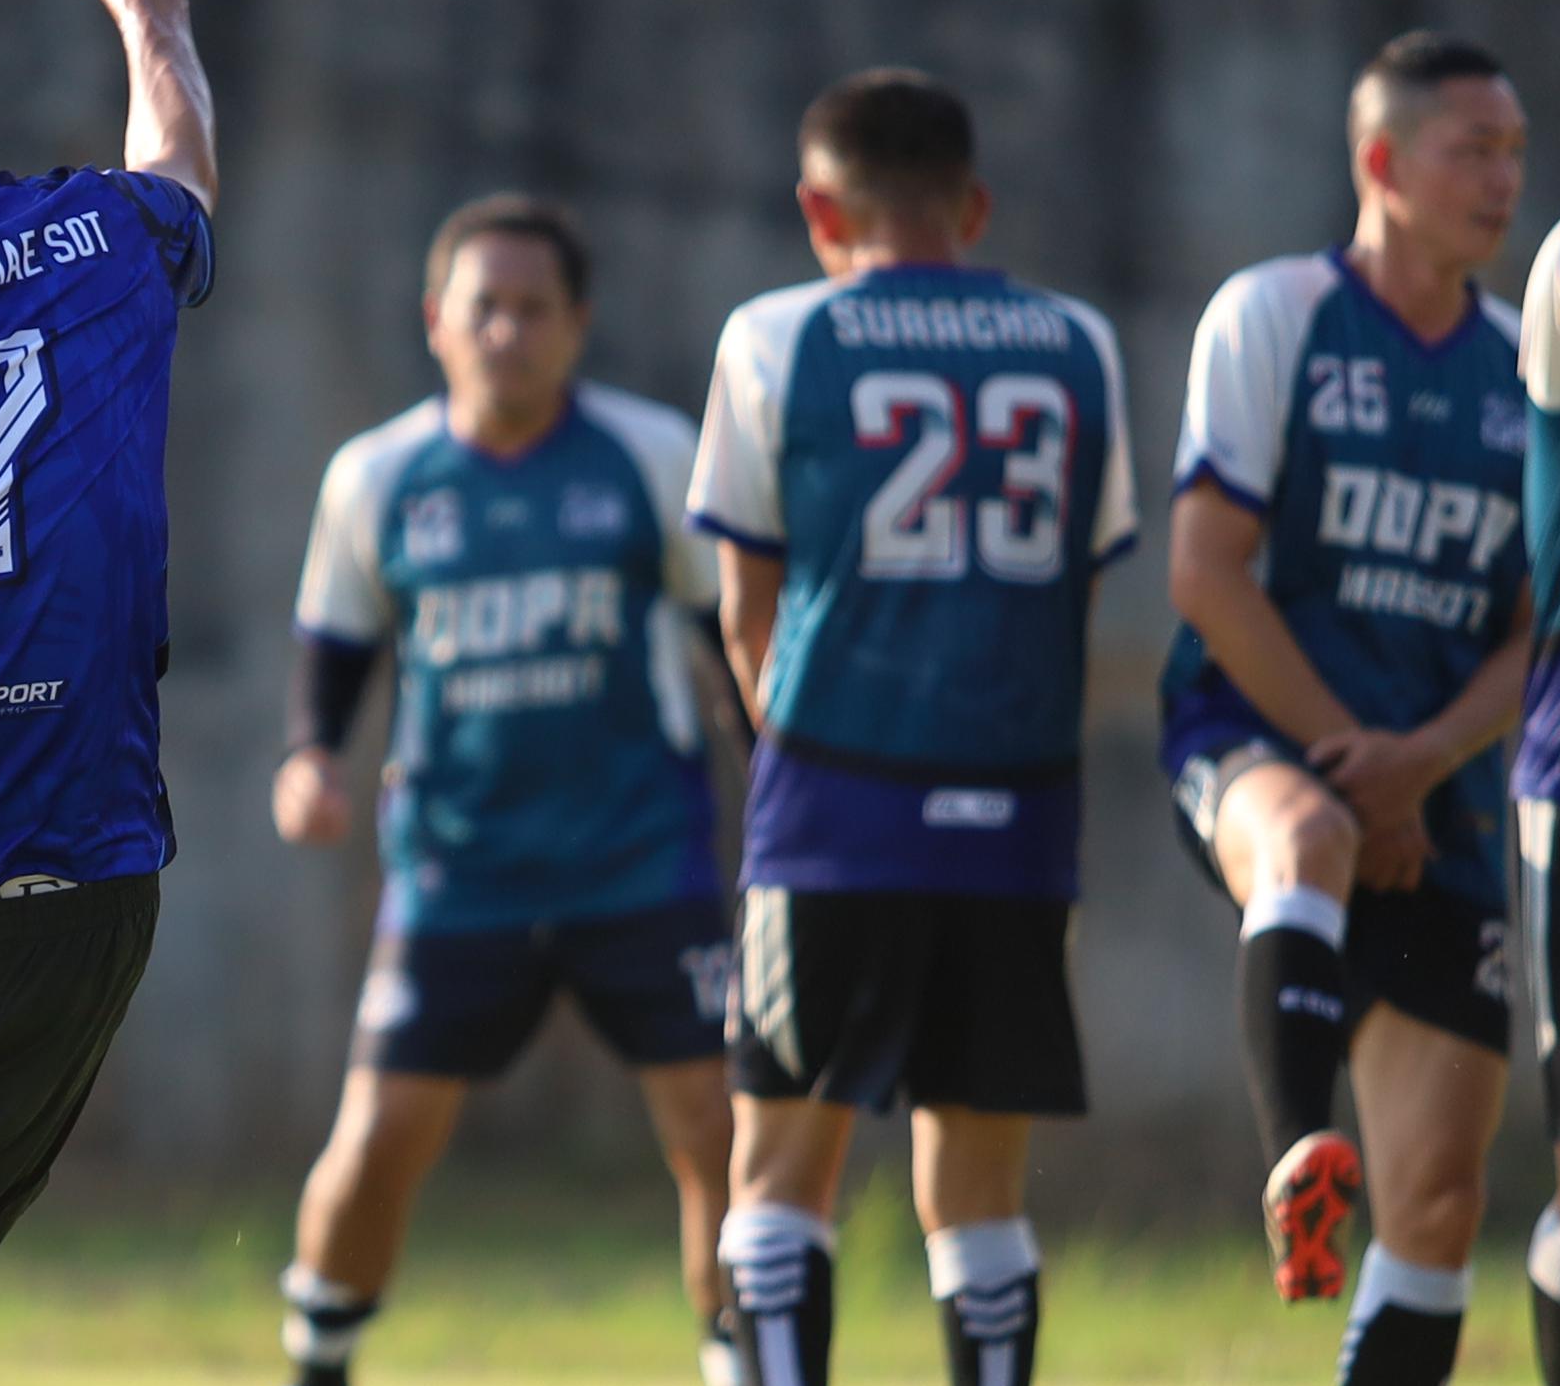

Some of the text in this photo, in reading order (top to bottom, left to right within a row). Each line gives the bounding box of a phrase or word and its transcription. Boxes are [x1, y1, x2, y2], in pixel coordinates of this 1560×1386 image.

[43, 211, 109, 264] SOT
[1306, 353, 1388, 435] 25
[850, 371, 1077, 582] 23
